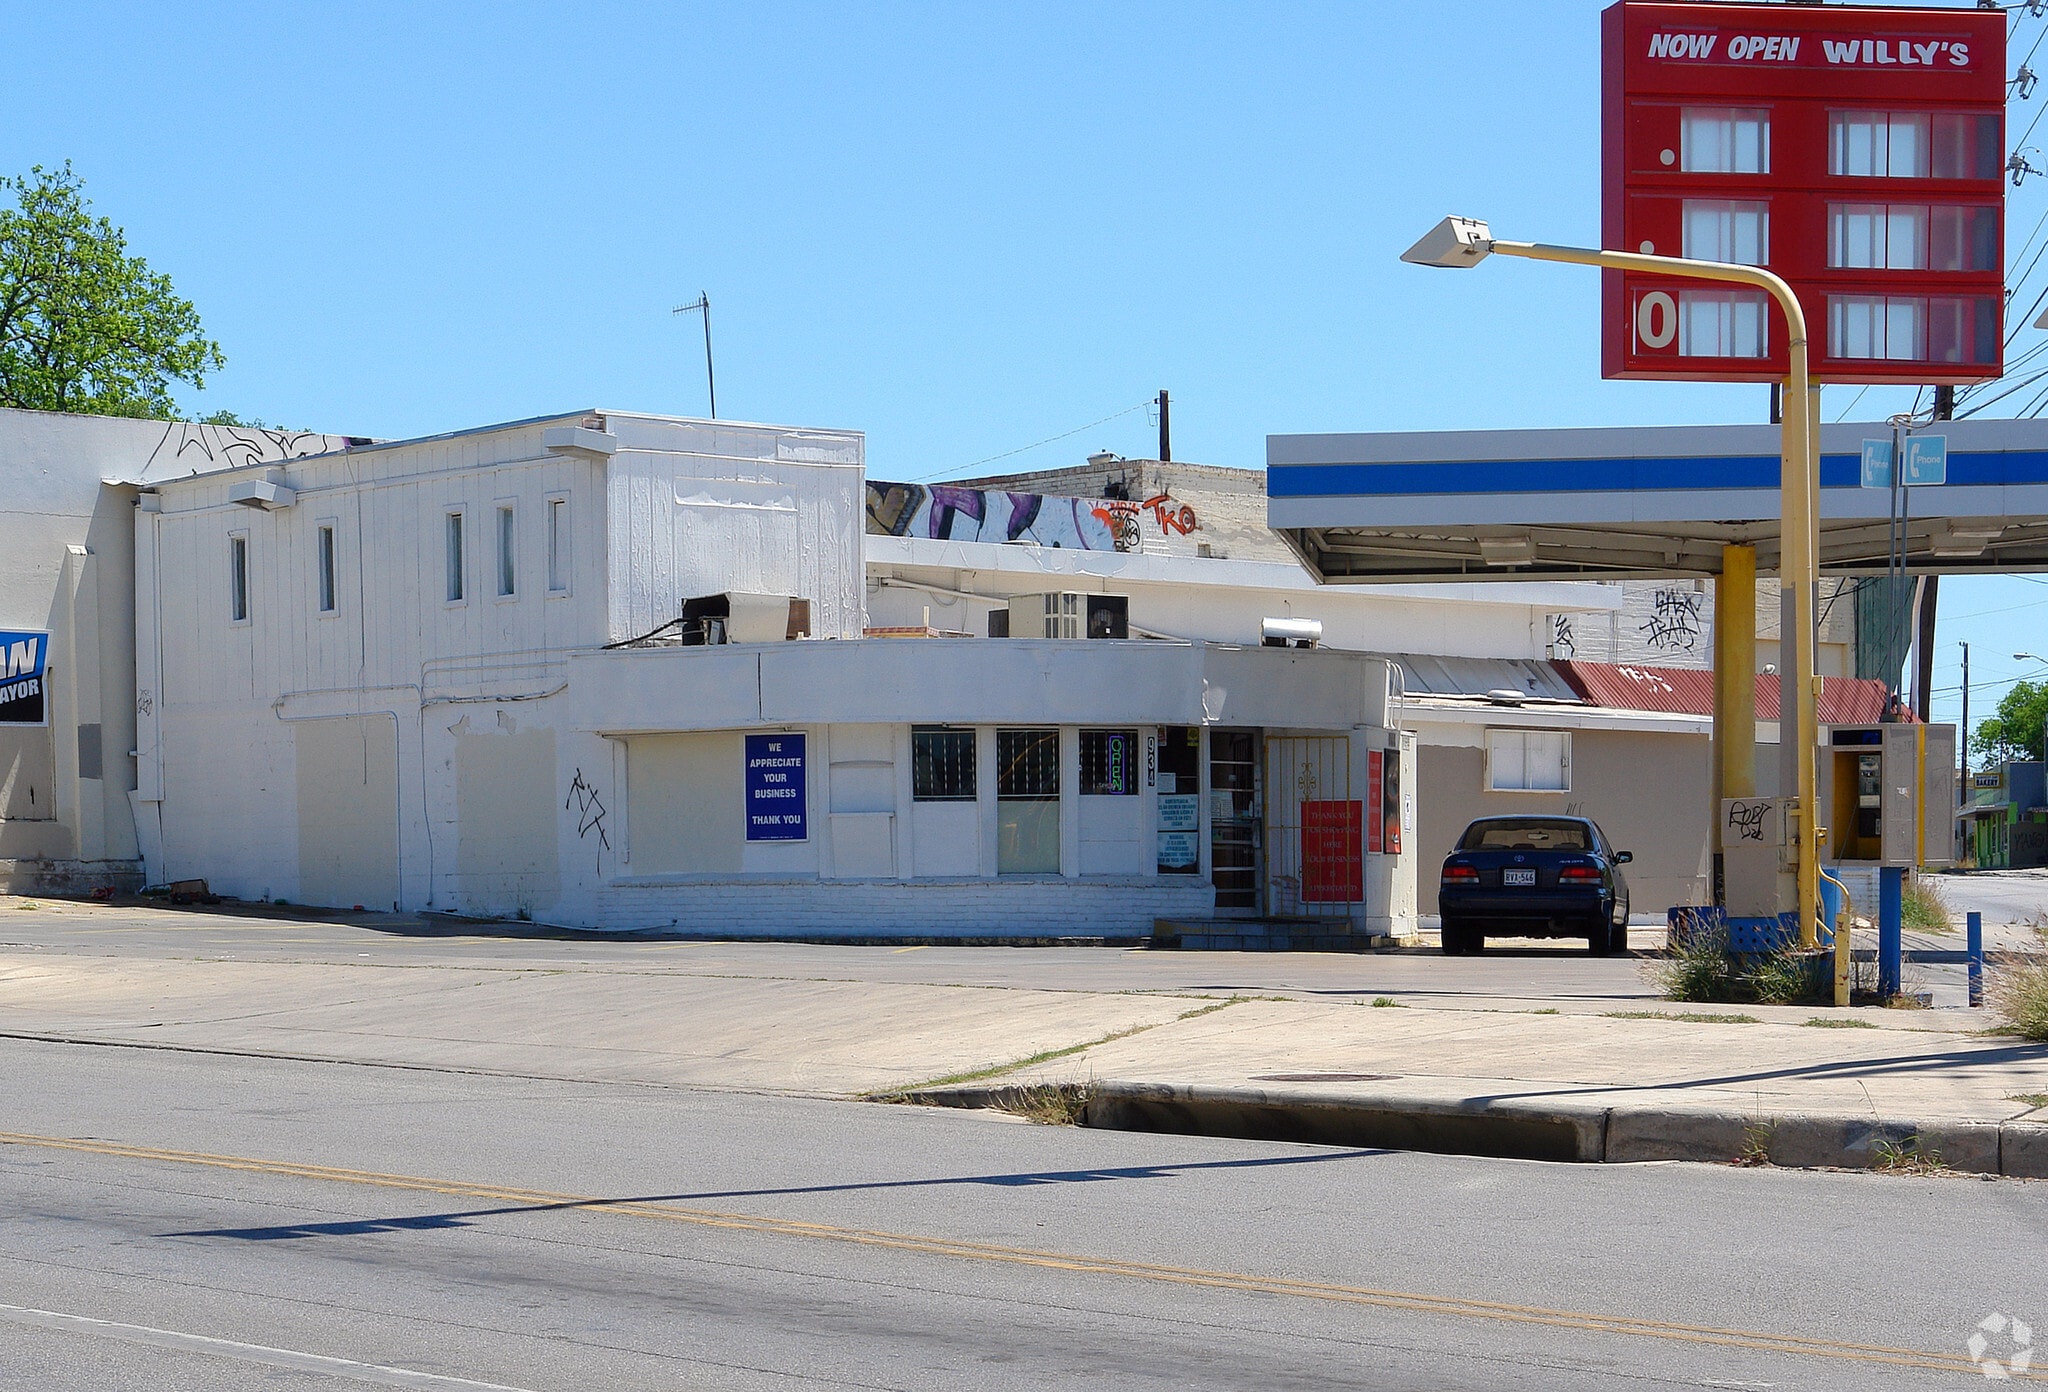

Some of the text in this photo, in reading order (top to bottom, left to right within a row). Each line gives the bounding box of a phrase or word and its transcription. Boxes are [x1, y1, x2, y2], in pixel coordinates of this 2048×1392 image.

[1647, 33, 1970, 66] NOW OPEN WILLY'S
[1637, 291, 1677, 349] 0
[1917, 456, 1941, 465] Phone
[1141, 494, 1196, 536] TKO
[0, 637, 38, 679] N
[768, 742, 782, 752] WE
[749, 757, 802, 768] APPRECIATE
[1111, 738, 1122, 791] OPEN
[763, 773, 787, 783] YOUR
[1976, 779, 1998, 787] BAKERY
[754, 788, 796, 799] BUSINESS
[752, 814, 801, 825] THANK YOU
[1311, 812, 1337, 820] THANK
